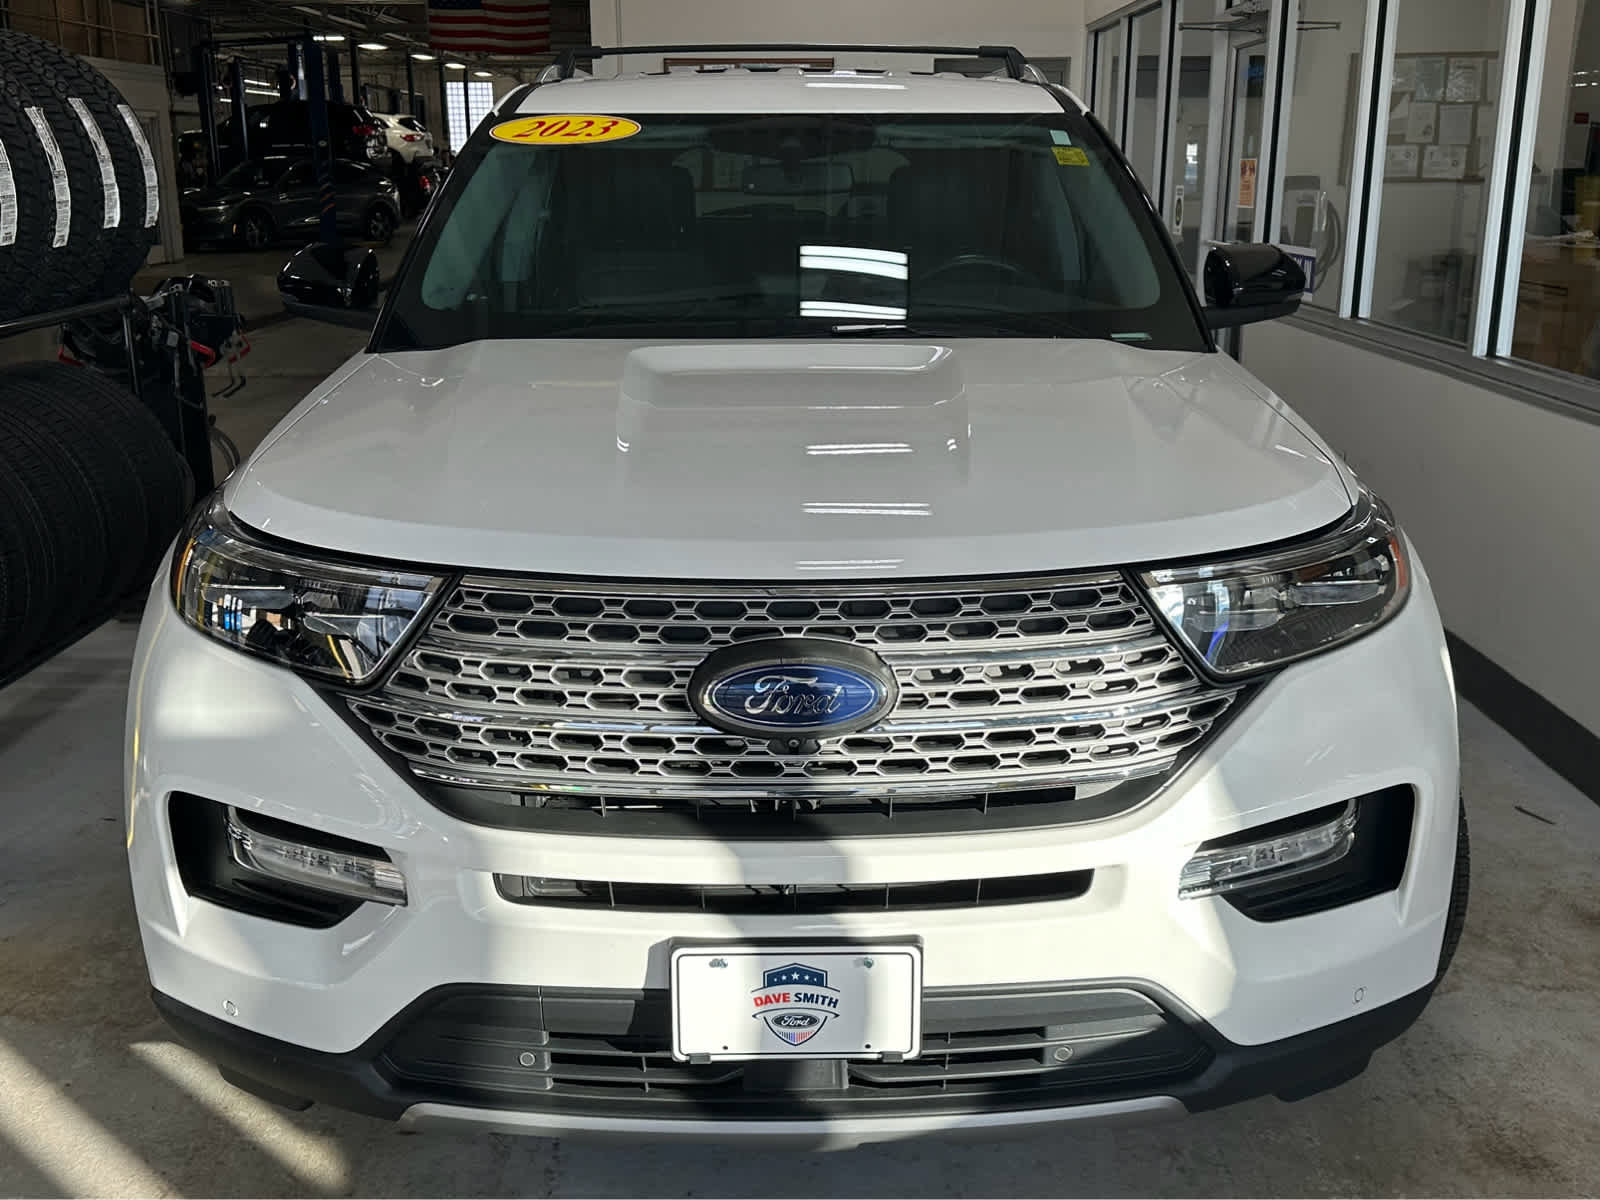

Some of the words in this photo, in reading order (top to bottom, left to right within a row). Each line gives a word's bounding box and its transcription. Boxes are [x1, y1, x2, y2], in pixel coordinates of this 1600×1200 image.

[512, 120, 619, 138] 2023
[744, 675, 842, 715] Ford
[753, 992, 791, 1007] DAVE
[794, 992, 839, 1009] SMITH
[780, 1014, 811, 1027] Ford
